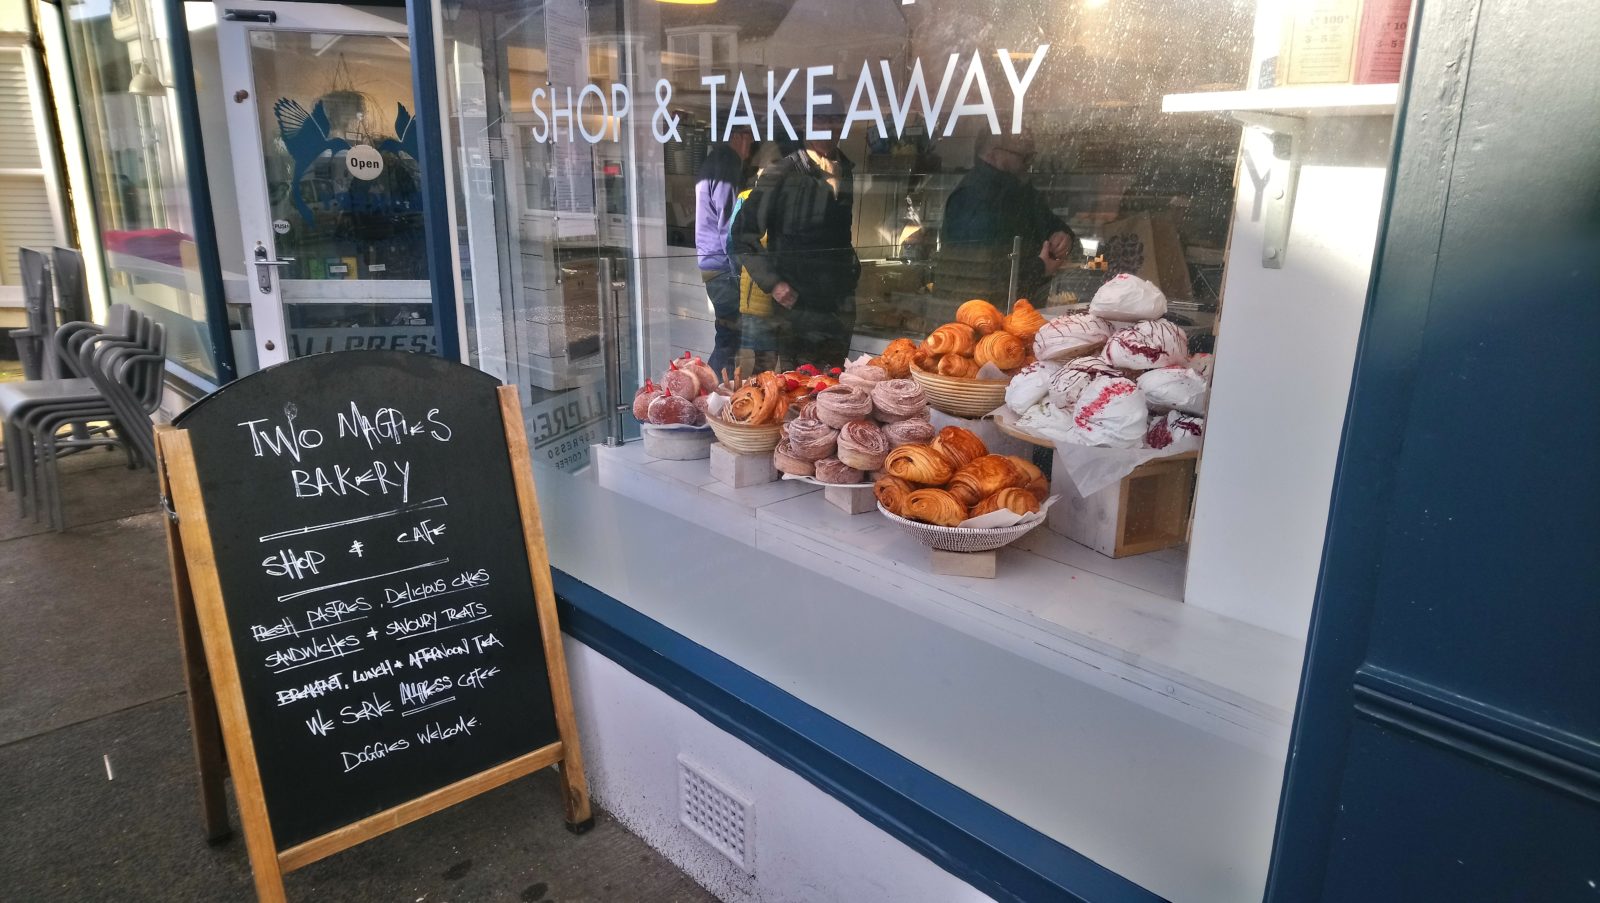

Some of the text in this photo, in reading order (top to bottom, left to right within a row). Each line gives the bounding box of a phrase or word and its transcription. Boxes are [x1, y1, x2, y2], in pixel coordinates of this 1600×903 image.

[531, 44, 1049, 144] SHOP & TAKEAWAY
[350, 157, 380, 170] Open
[237, 401, 452, 462] TWO MAGPIES
[292, 461, 409, 503] BAKERY
[262, 549, 325, 579] SHOP
[397, 519, 446, 544] CAFE
[251, 617, 299, 642] FRESH
[384, 579, 447, 603] DELICIOUS
[452, 569, 489, 587] CAKES
[265, 634, 360, 667] SANDWICHES
[386, 611, 437, 635] SAVOURY
[441, 602, 487, 621] TREATS
[409, 638, 469, 669] AFTERNOON
[471, 633, 504, 653] TEA
[306, 709, 336, 736] WE
[340, 692, 394, 724] SERVE
[340, 739, 410, 773] DOGGIES
